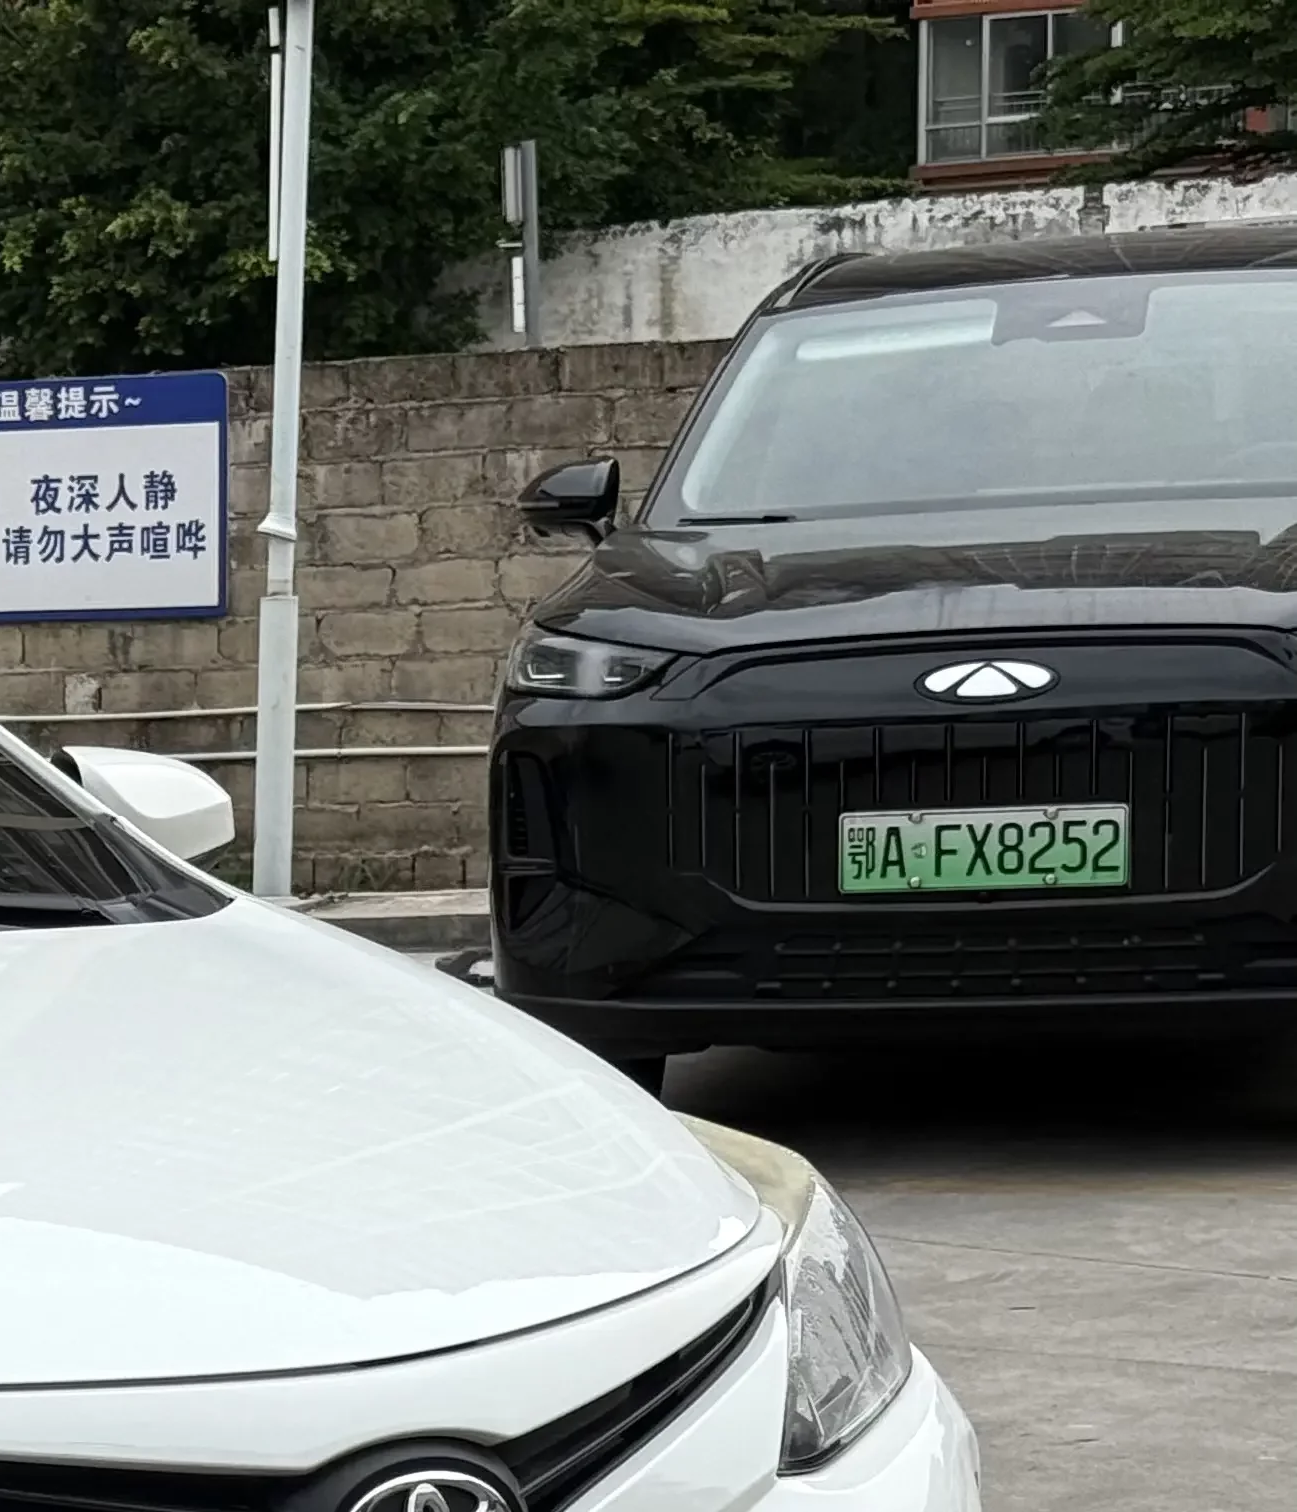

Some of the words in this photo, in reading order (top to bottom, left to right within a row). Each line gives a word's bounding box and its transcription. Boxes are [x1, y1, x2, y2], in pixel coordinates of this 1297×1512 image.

[30, 470, 178, 515] 夜深人静
[2, 519, 206, 566] 请勿大声喧哗
